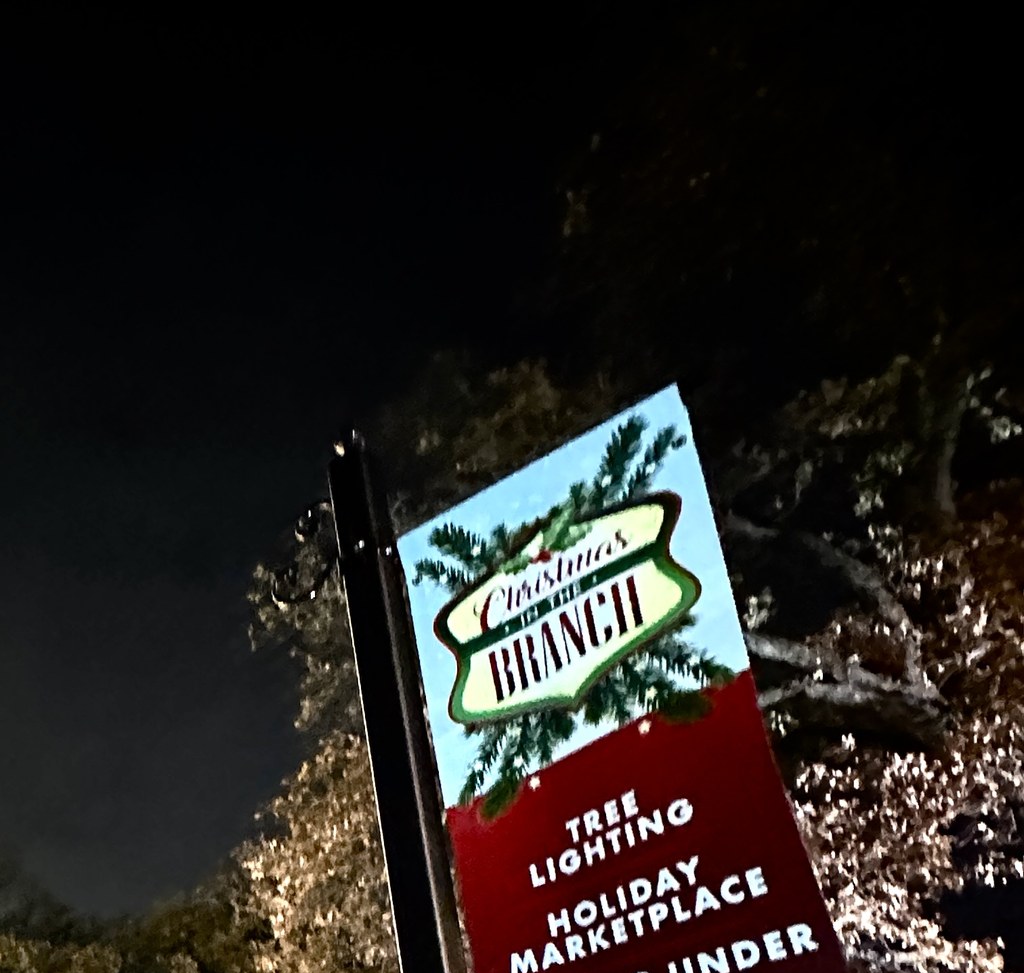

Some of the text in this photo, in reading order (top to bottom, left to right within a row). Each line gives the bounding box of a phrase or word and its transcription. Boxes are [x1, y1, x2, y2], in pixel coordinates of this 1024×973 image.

[488, 575, 643, 703] BRANCH
[529, 798, 693, 887] LIGHTING
[565, 789, 639, 843] TREE
[547, 855, 698, 937] HOLIDAY
